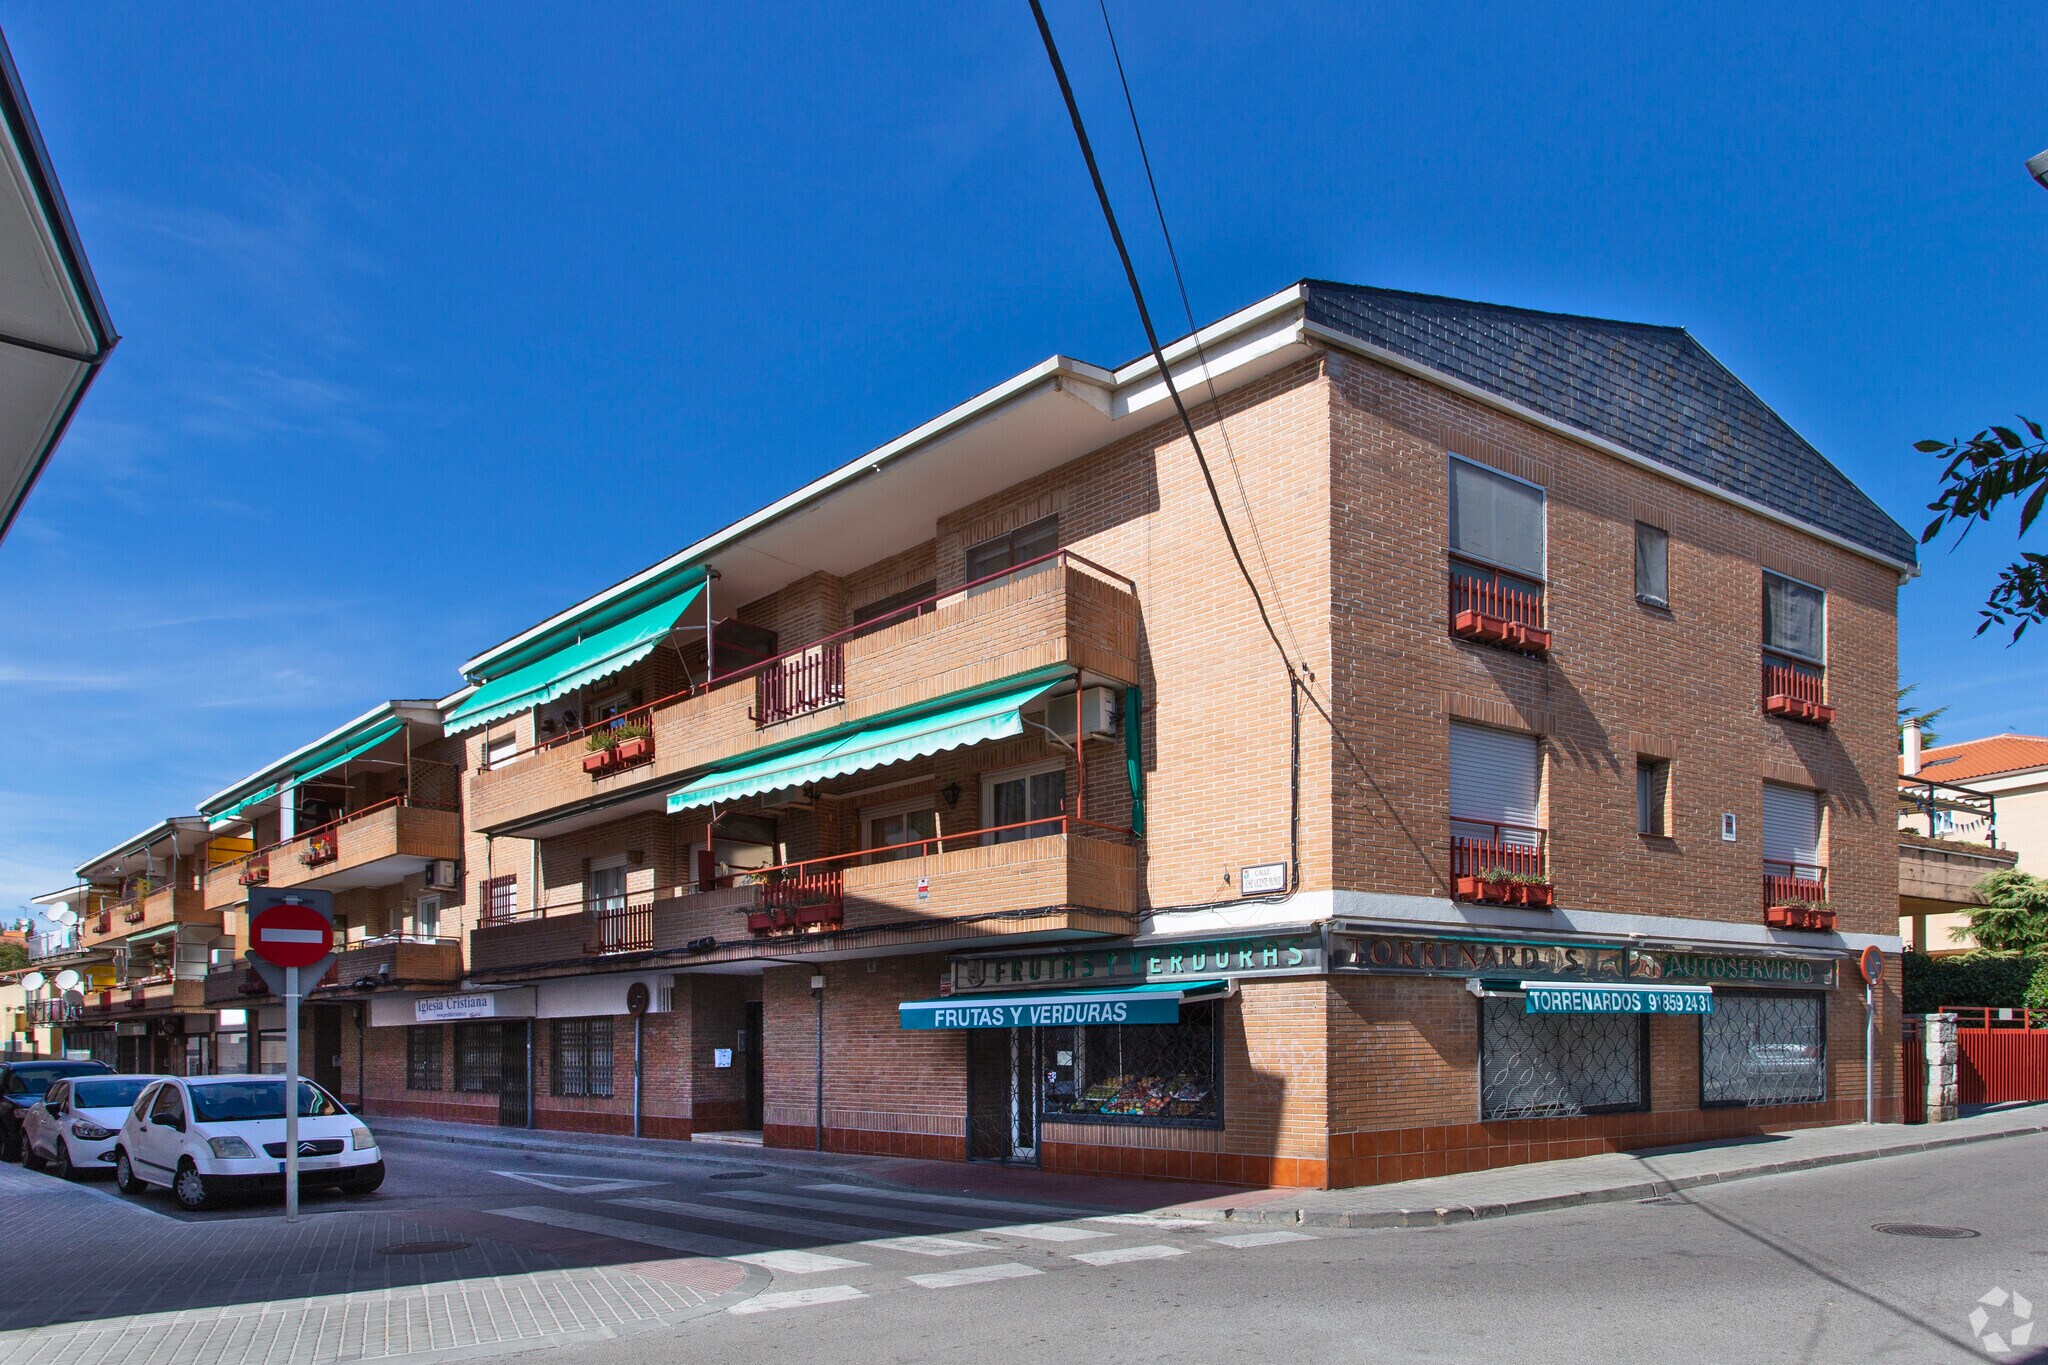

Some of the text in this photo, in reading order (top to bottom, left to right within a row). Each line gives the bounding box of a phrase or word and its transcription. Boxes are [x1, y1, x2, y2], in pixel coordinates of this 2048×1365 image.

[995, 938, 1304, 983] FRUTAS Y VERDURAS
[1664, 956, 1813, 981] AUTOSERVICIO
[418, 999, 443, 1015] Iglesia
[446, 996, 488, 1010] Cristiana
[1530, 991, 1641, 1012] TORRENARDOS
[1685, 995, 1698, 1012] 24
[1699, 996, 1711, 1012] 31
[935, 1002, 1127, 1027] FRUTAS Y VERDURAS
